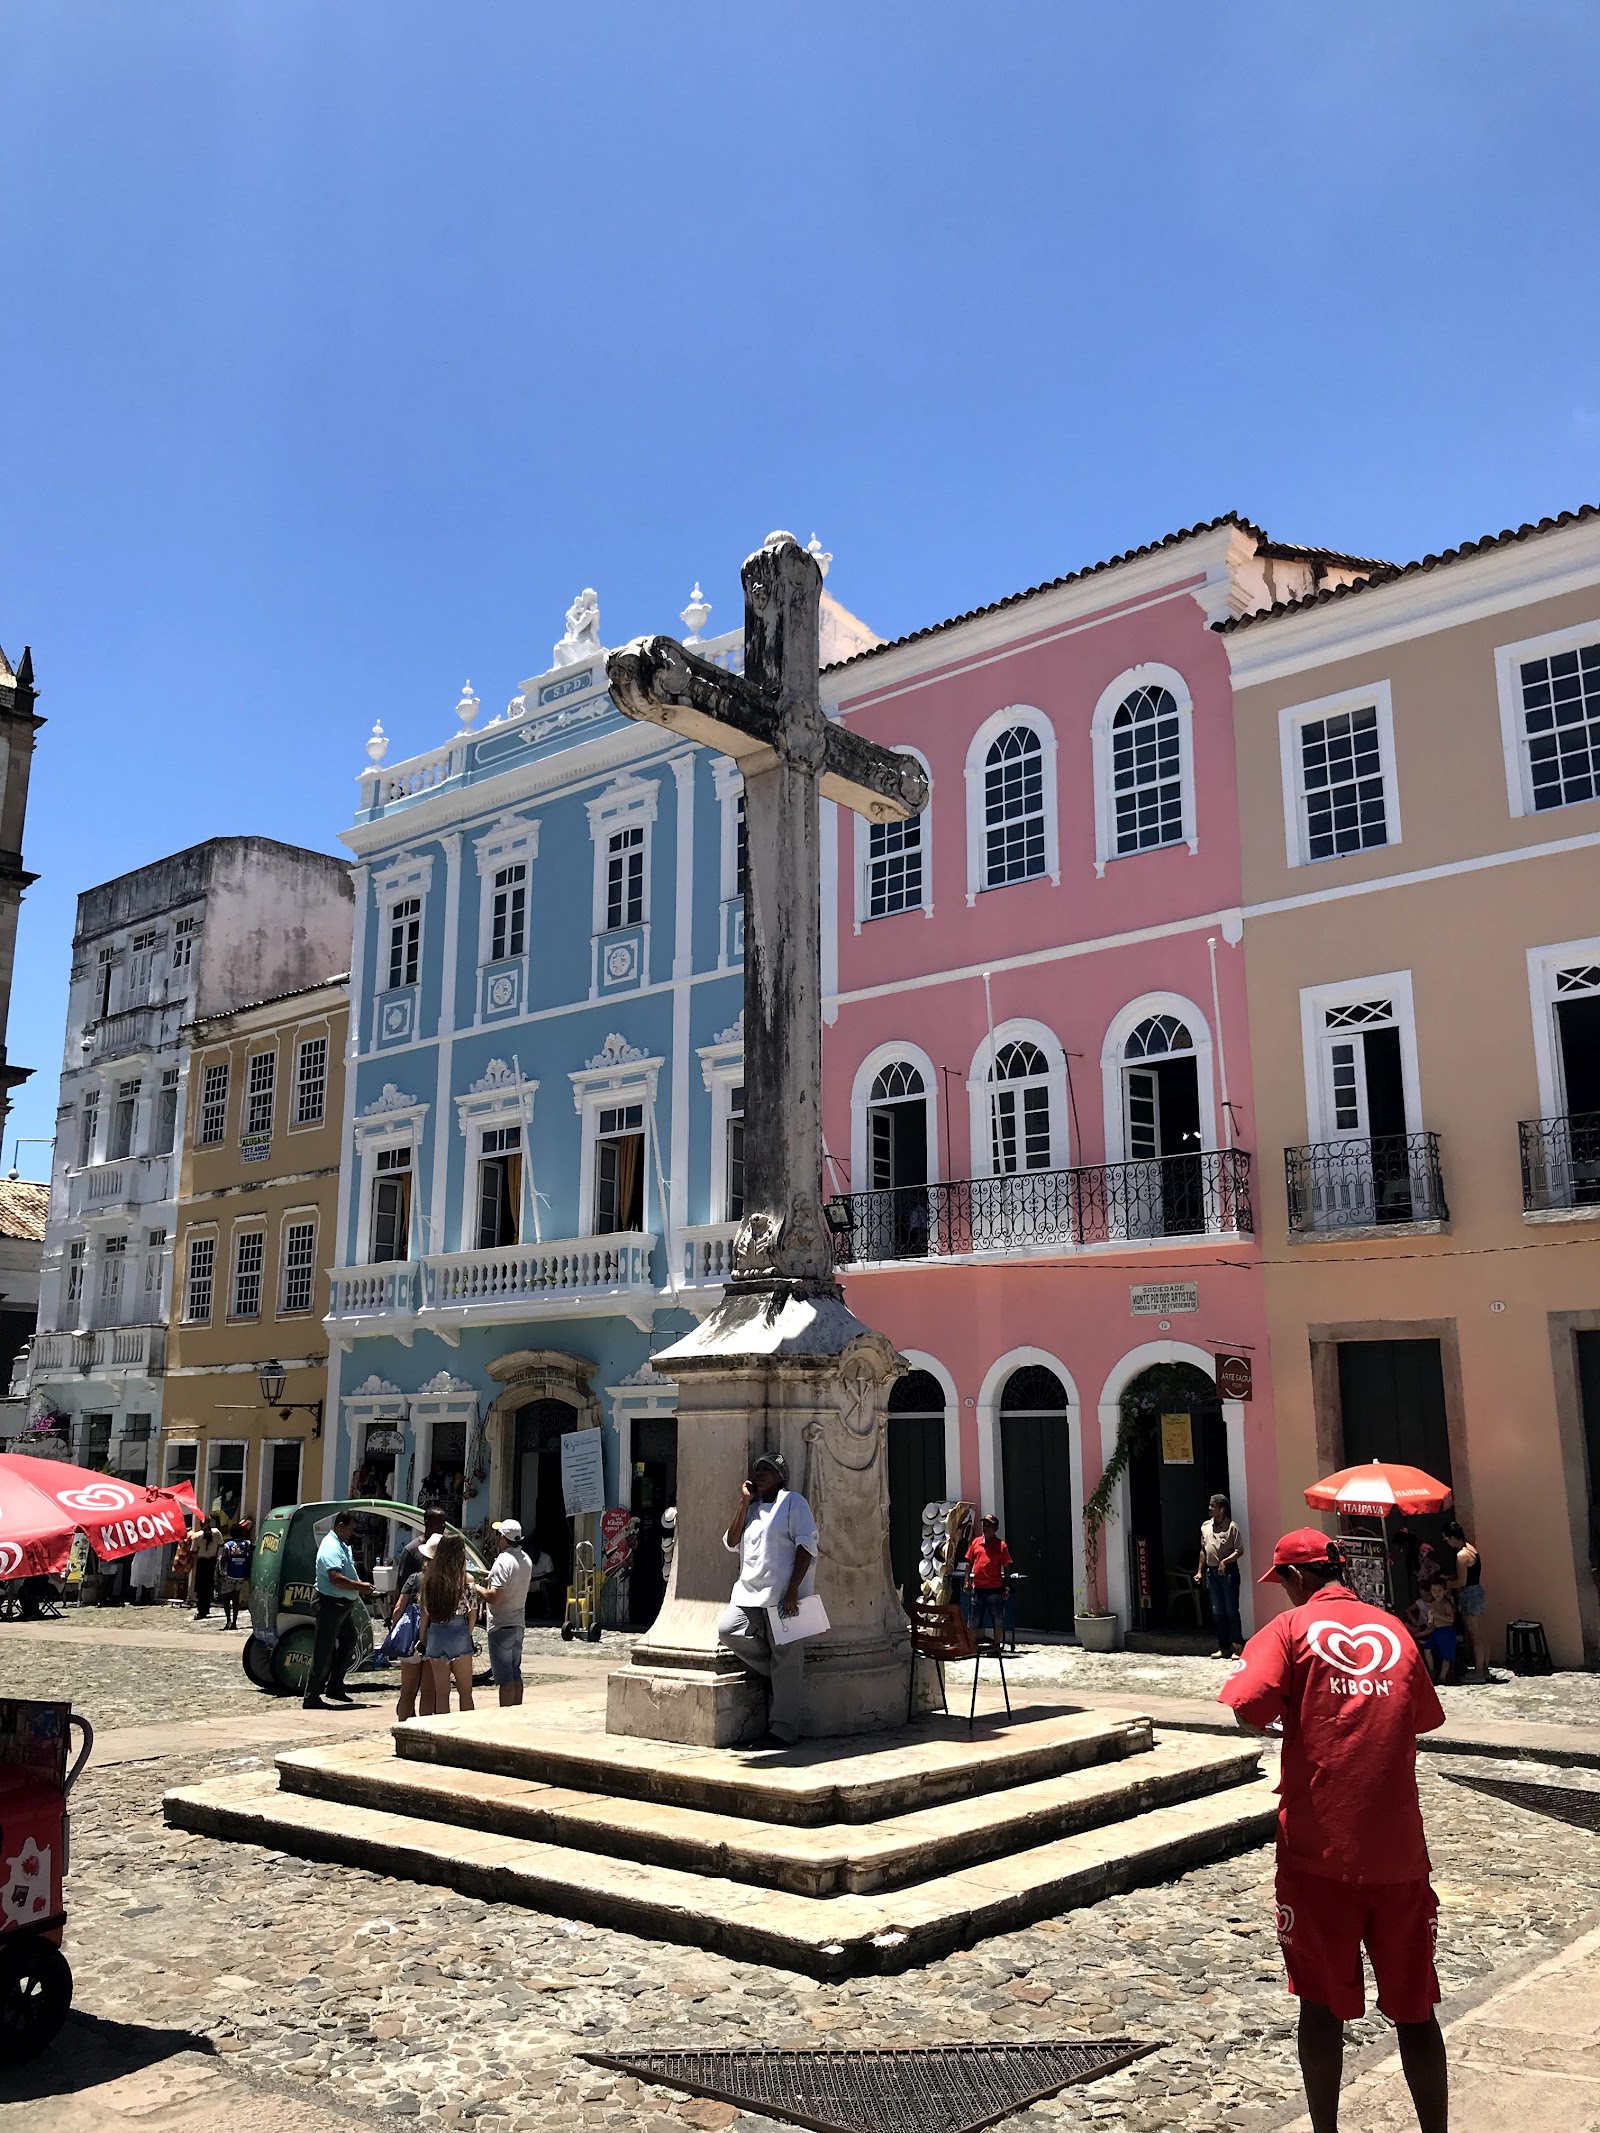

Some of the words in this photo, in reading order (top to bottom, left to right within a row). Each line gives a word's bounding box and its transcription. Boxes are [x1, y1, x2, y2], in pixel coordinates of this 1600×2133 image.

[242, 1135, 270, 1147] ALUGA-SE
[1143, 1285, 1185, 1293] SOCIEDADE
[1132, 1294, 1150, 1305] MONTE
[1151, 1294, 1159, 1304] PIO
[1160, 1293, 1170, 1303] DOS
[1172, 1291, 1197, 1302] ARTISTAS
[1236, 1374, 1251, 1383] SACRA
[1394, 1488, 1431, 1498] ITAIPAVA
[1343, 1503, 1384, 1515] ITAIPAVA
[101, 1512, 175, 1551] KIBON
[1138, 1540, 1148, 1595] WECHSEL
